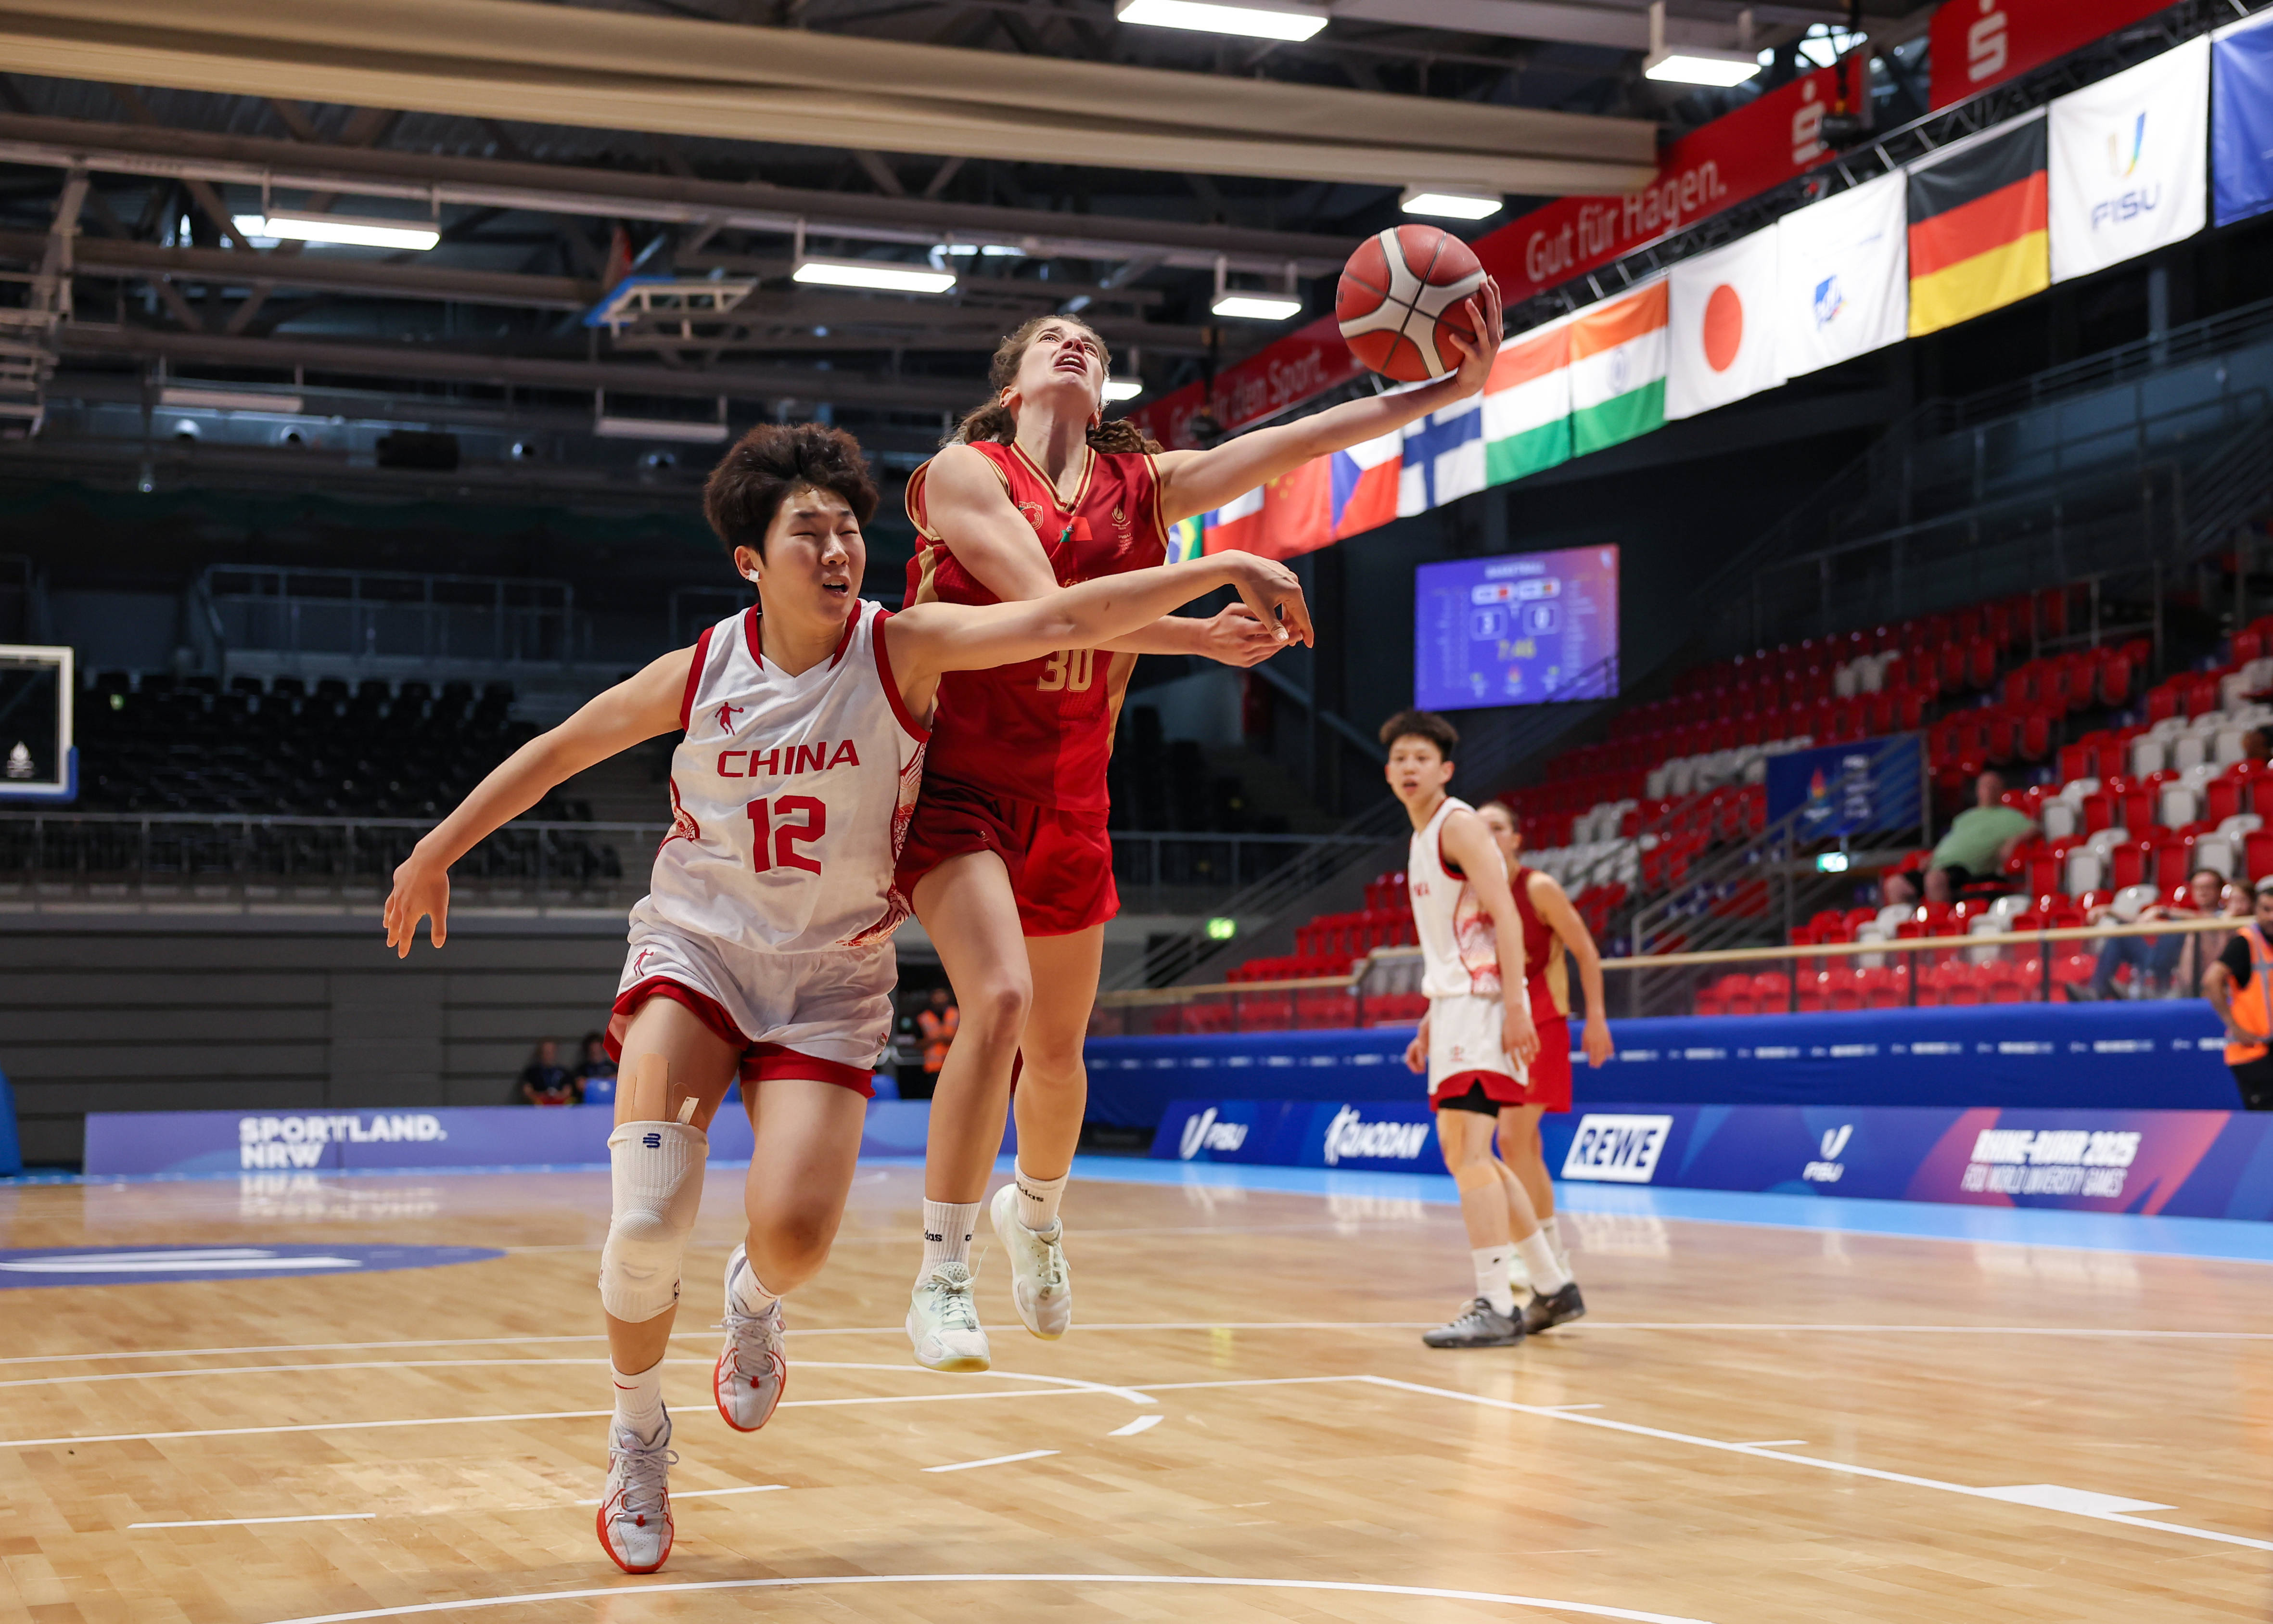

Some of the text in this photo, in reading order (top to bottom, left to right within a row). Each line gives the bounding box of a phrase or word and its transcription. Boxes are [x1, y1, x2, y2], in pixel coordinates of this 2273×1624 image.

[1526, 160, 1727, 283] Gut für Hagen.
[2091, 182, 2162, 233] FISU
[1036, 649, 1094, 692] 30
[717, 739, 860, 778] CHINA
[747, 795, 826, 876] 12
[239, 1114, 447, 1143] SPORTLAND.
[1572, 1126, 1658, 1167] REWE
[241, 1141, 325, 1169] NRW
[1802, 1161, 1845, 1183] FISU
